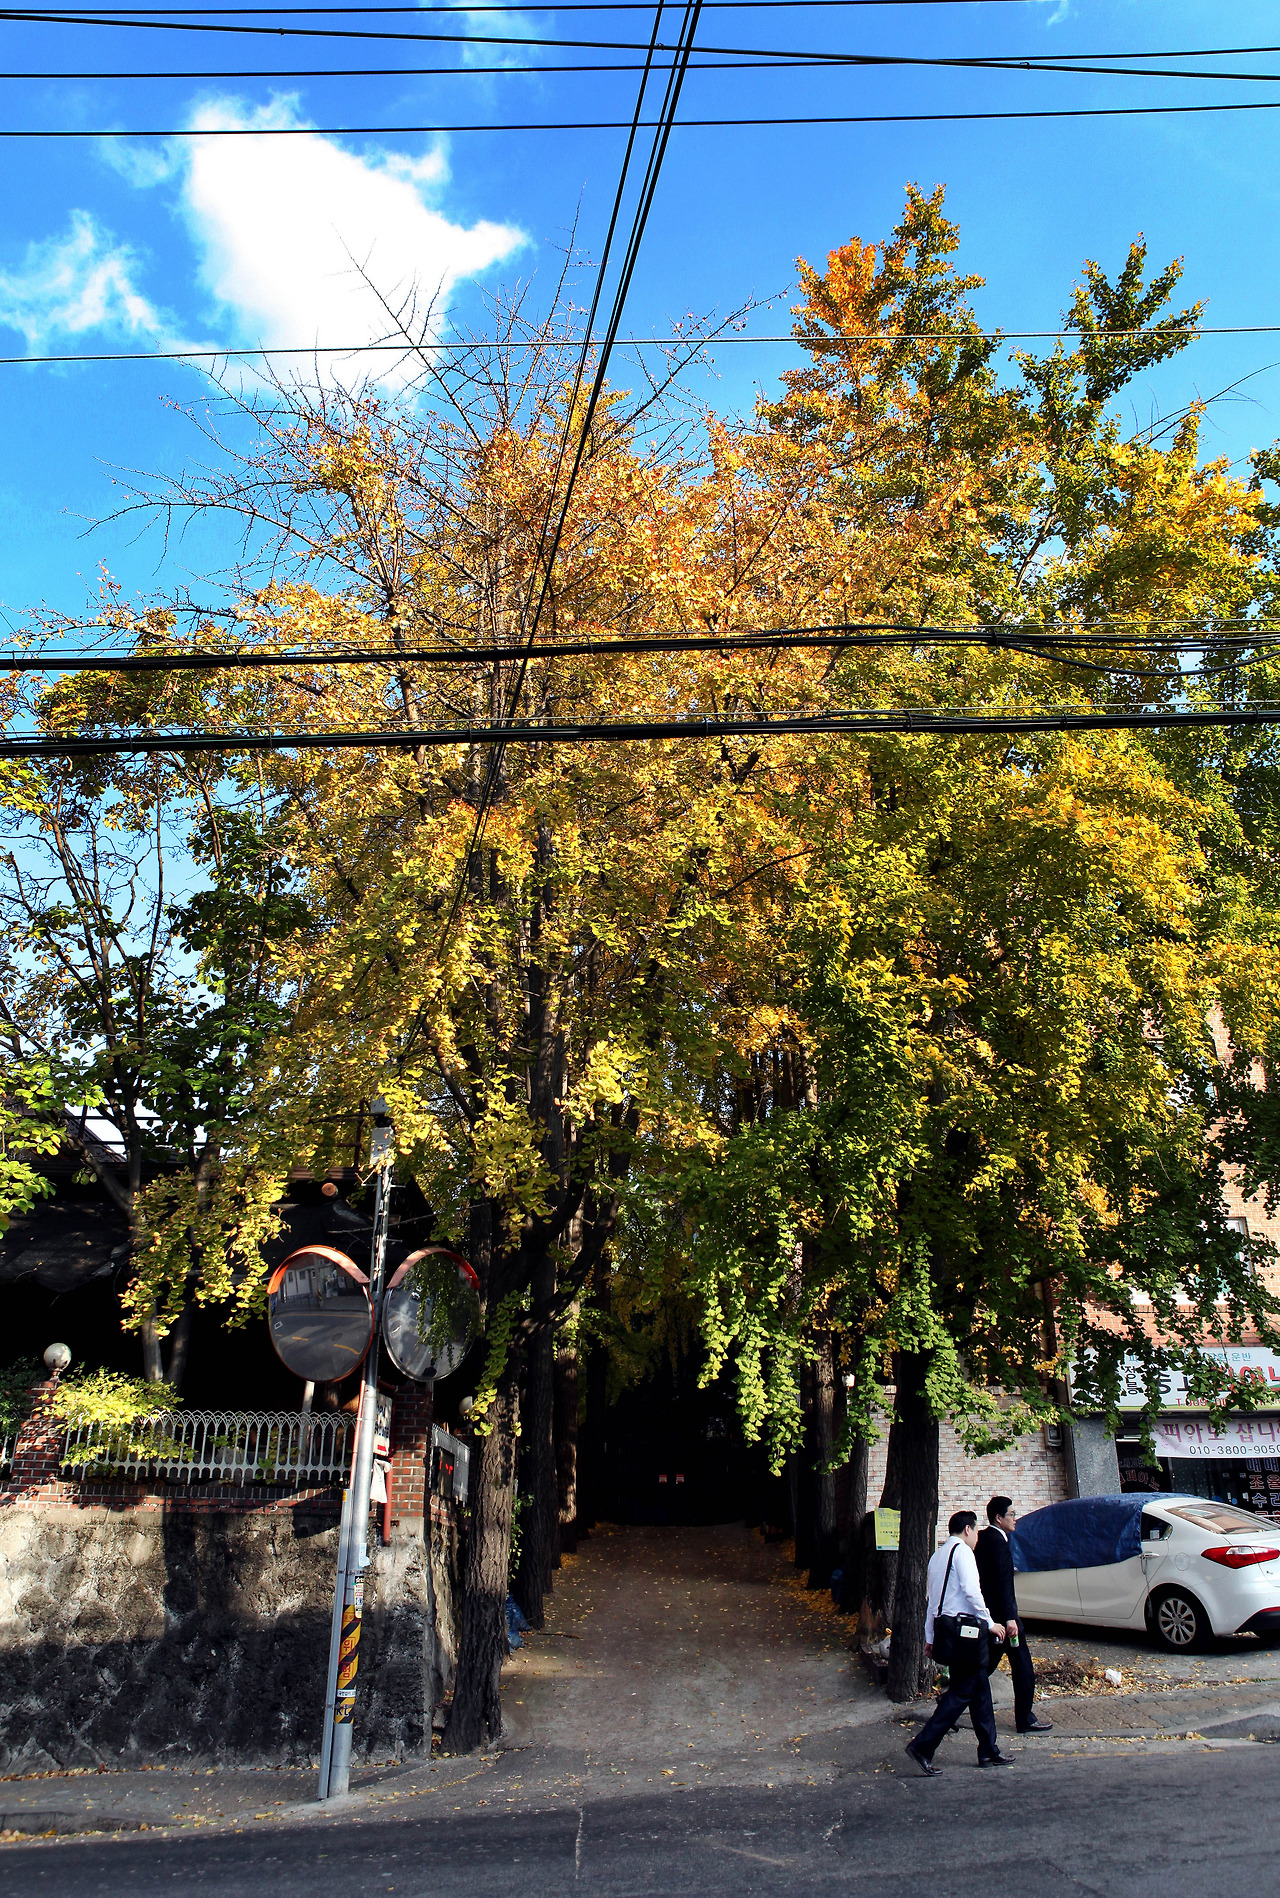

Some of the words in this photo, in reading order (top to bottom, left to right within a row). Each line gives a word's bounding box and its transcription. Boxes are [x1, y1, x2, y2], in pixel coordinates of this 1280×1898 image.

[1163, 1423, 1225, 1443] 피아노
[1236, 1423, 1280, 1442] 삽니
[1249, 1475, 1280, 1490] 조율
